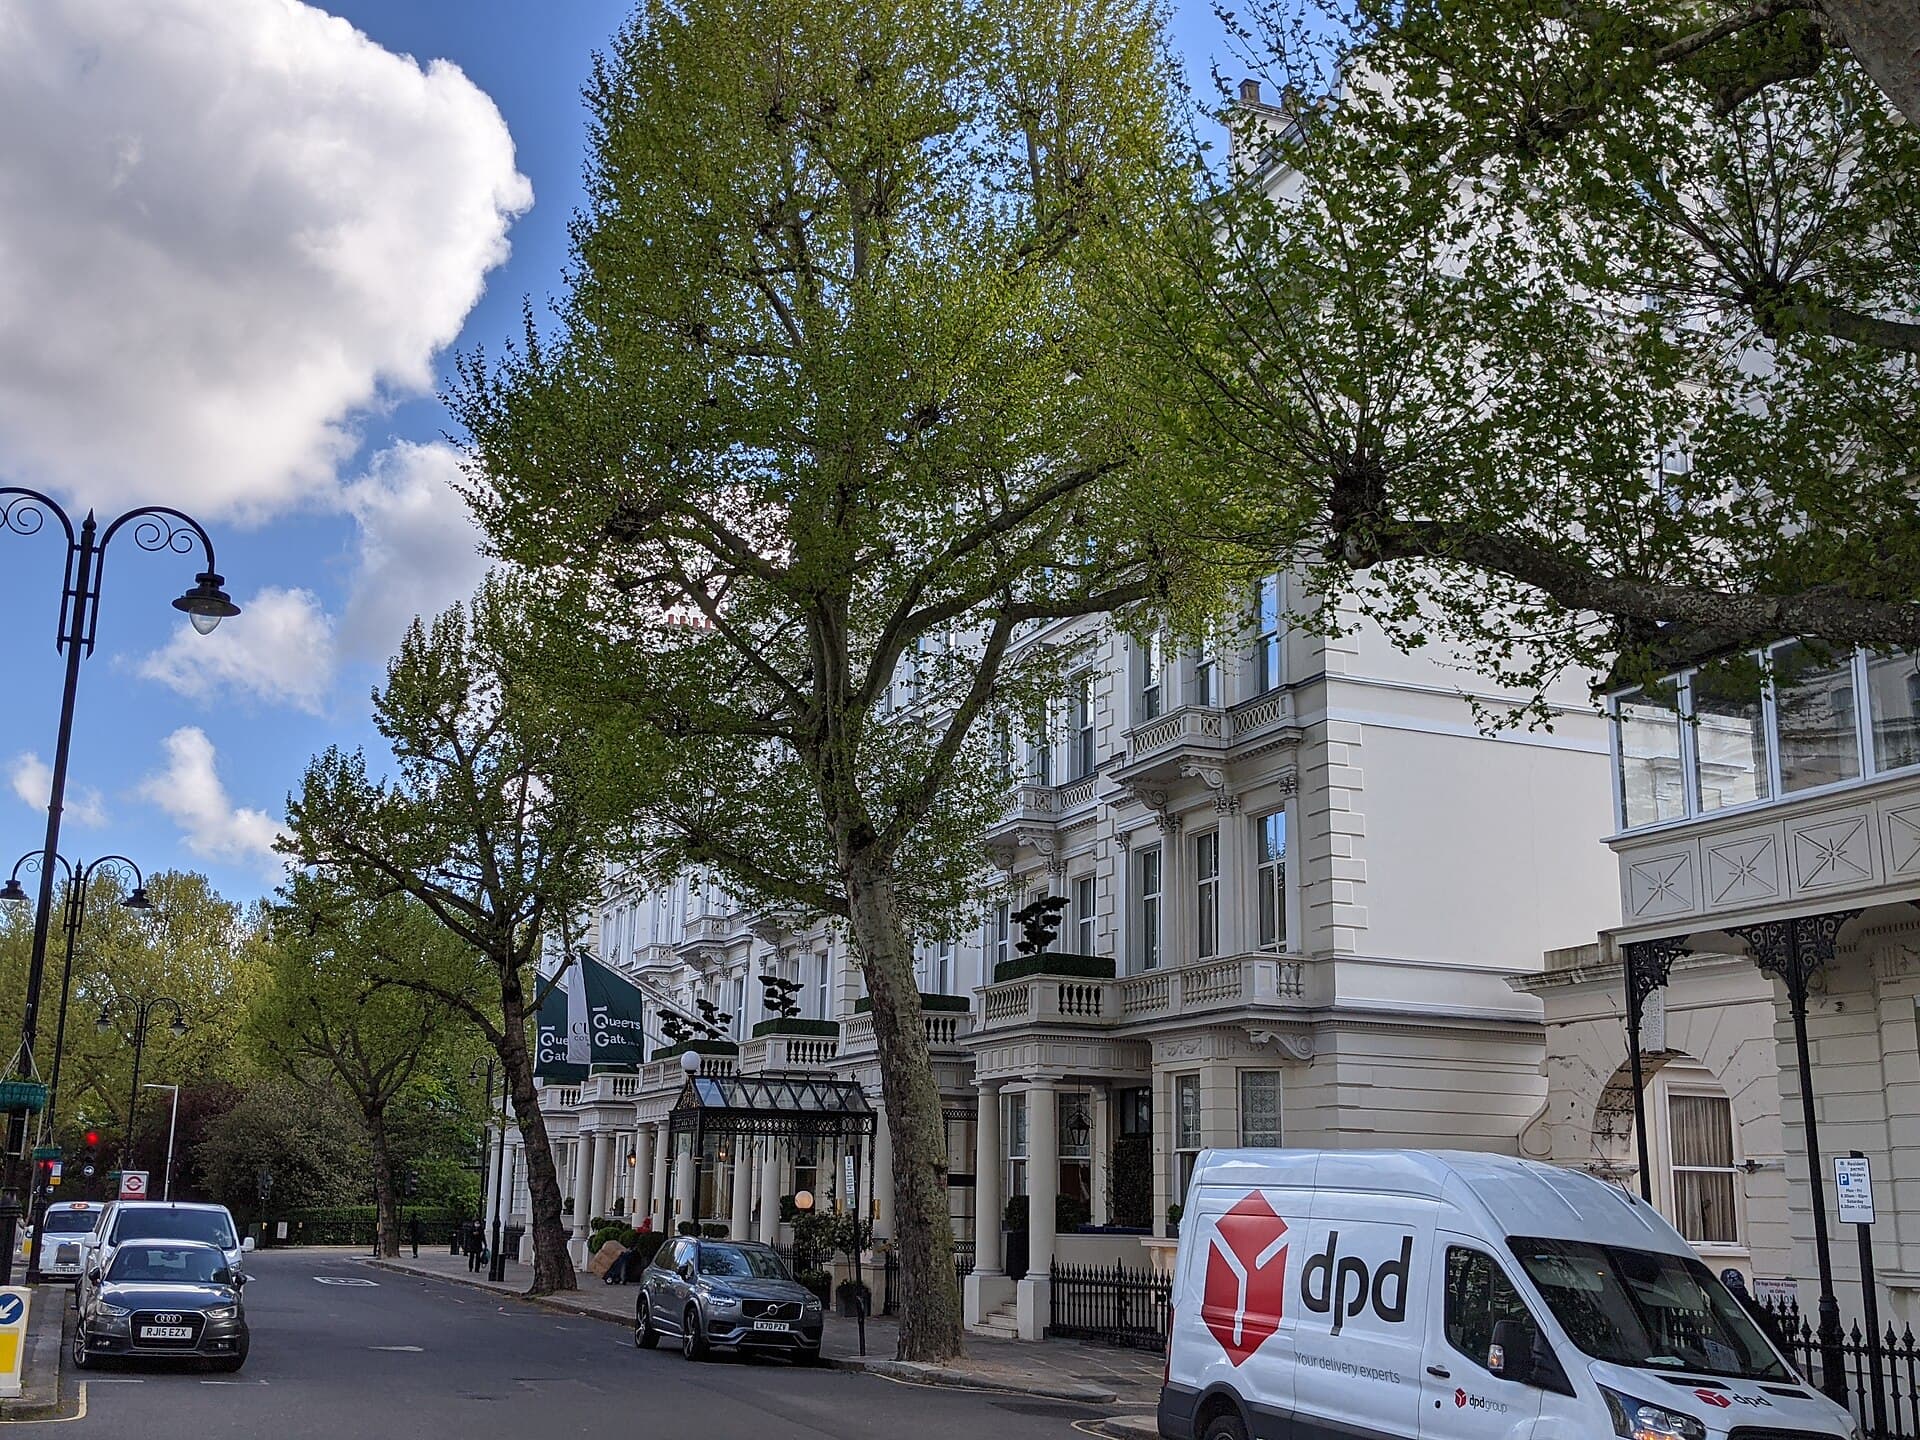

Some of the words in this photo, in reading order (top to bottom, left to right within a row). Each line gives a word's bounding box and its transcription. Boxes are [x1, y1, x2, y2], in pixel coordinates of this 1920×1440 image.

[1300, 1230, 1414, 1337] dpd
[147, 1327, 168, 1337] RJ15
[168, 1328, 188, 1338] EZX
[1294, 1353, 1319, 1368] Your
[1319, 1356, 1358, 1379] delivery
[1359, 1365, 1401, 1385] experts
[1469, 1394, 1508, 1415] dpdgroup
[1732, 1393, 1774, 1408] dpd
